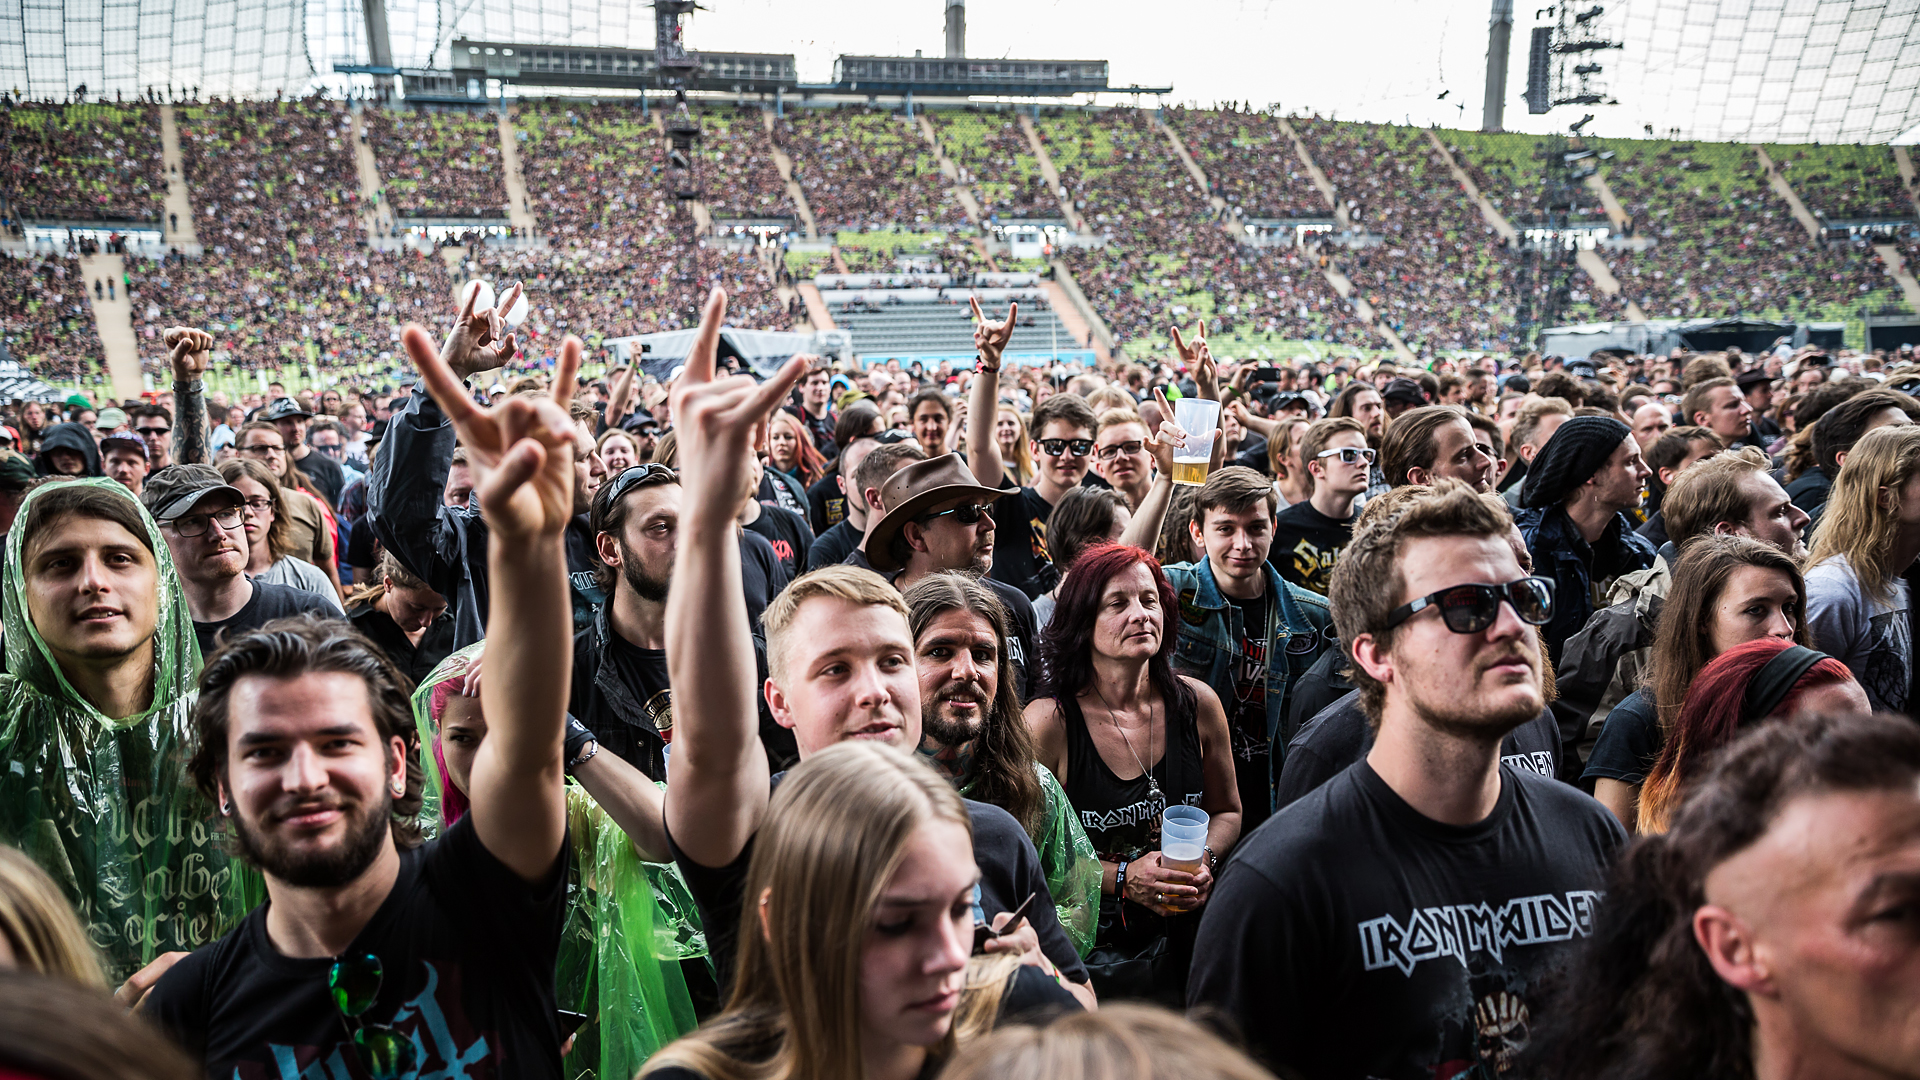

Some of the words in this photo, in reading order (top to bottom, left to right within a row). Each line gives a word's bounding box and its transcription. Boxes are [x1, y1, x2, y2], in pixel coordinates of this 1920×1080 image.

[1081, 804, 1137, 832] IRON
[1358, 905, 1467, 978] IRON
[1456, 891, 1604, 964] MAIDE
